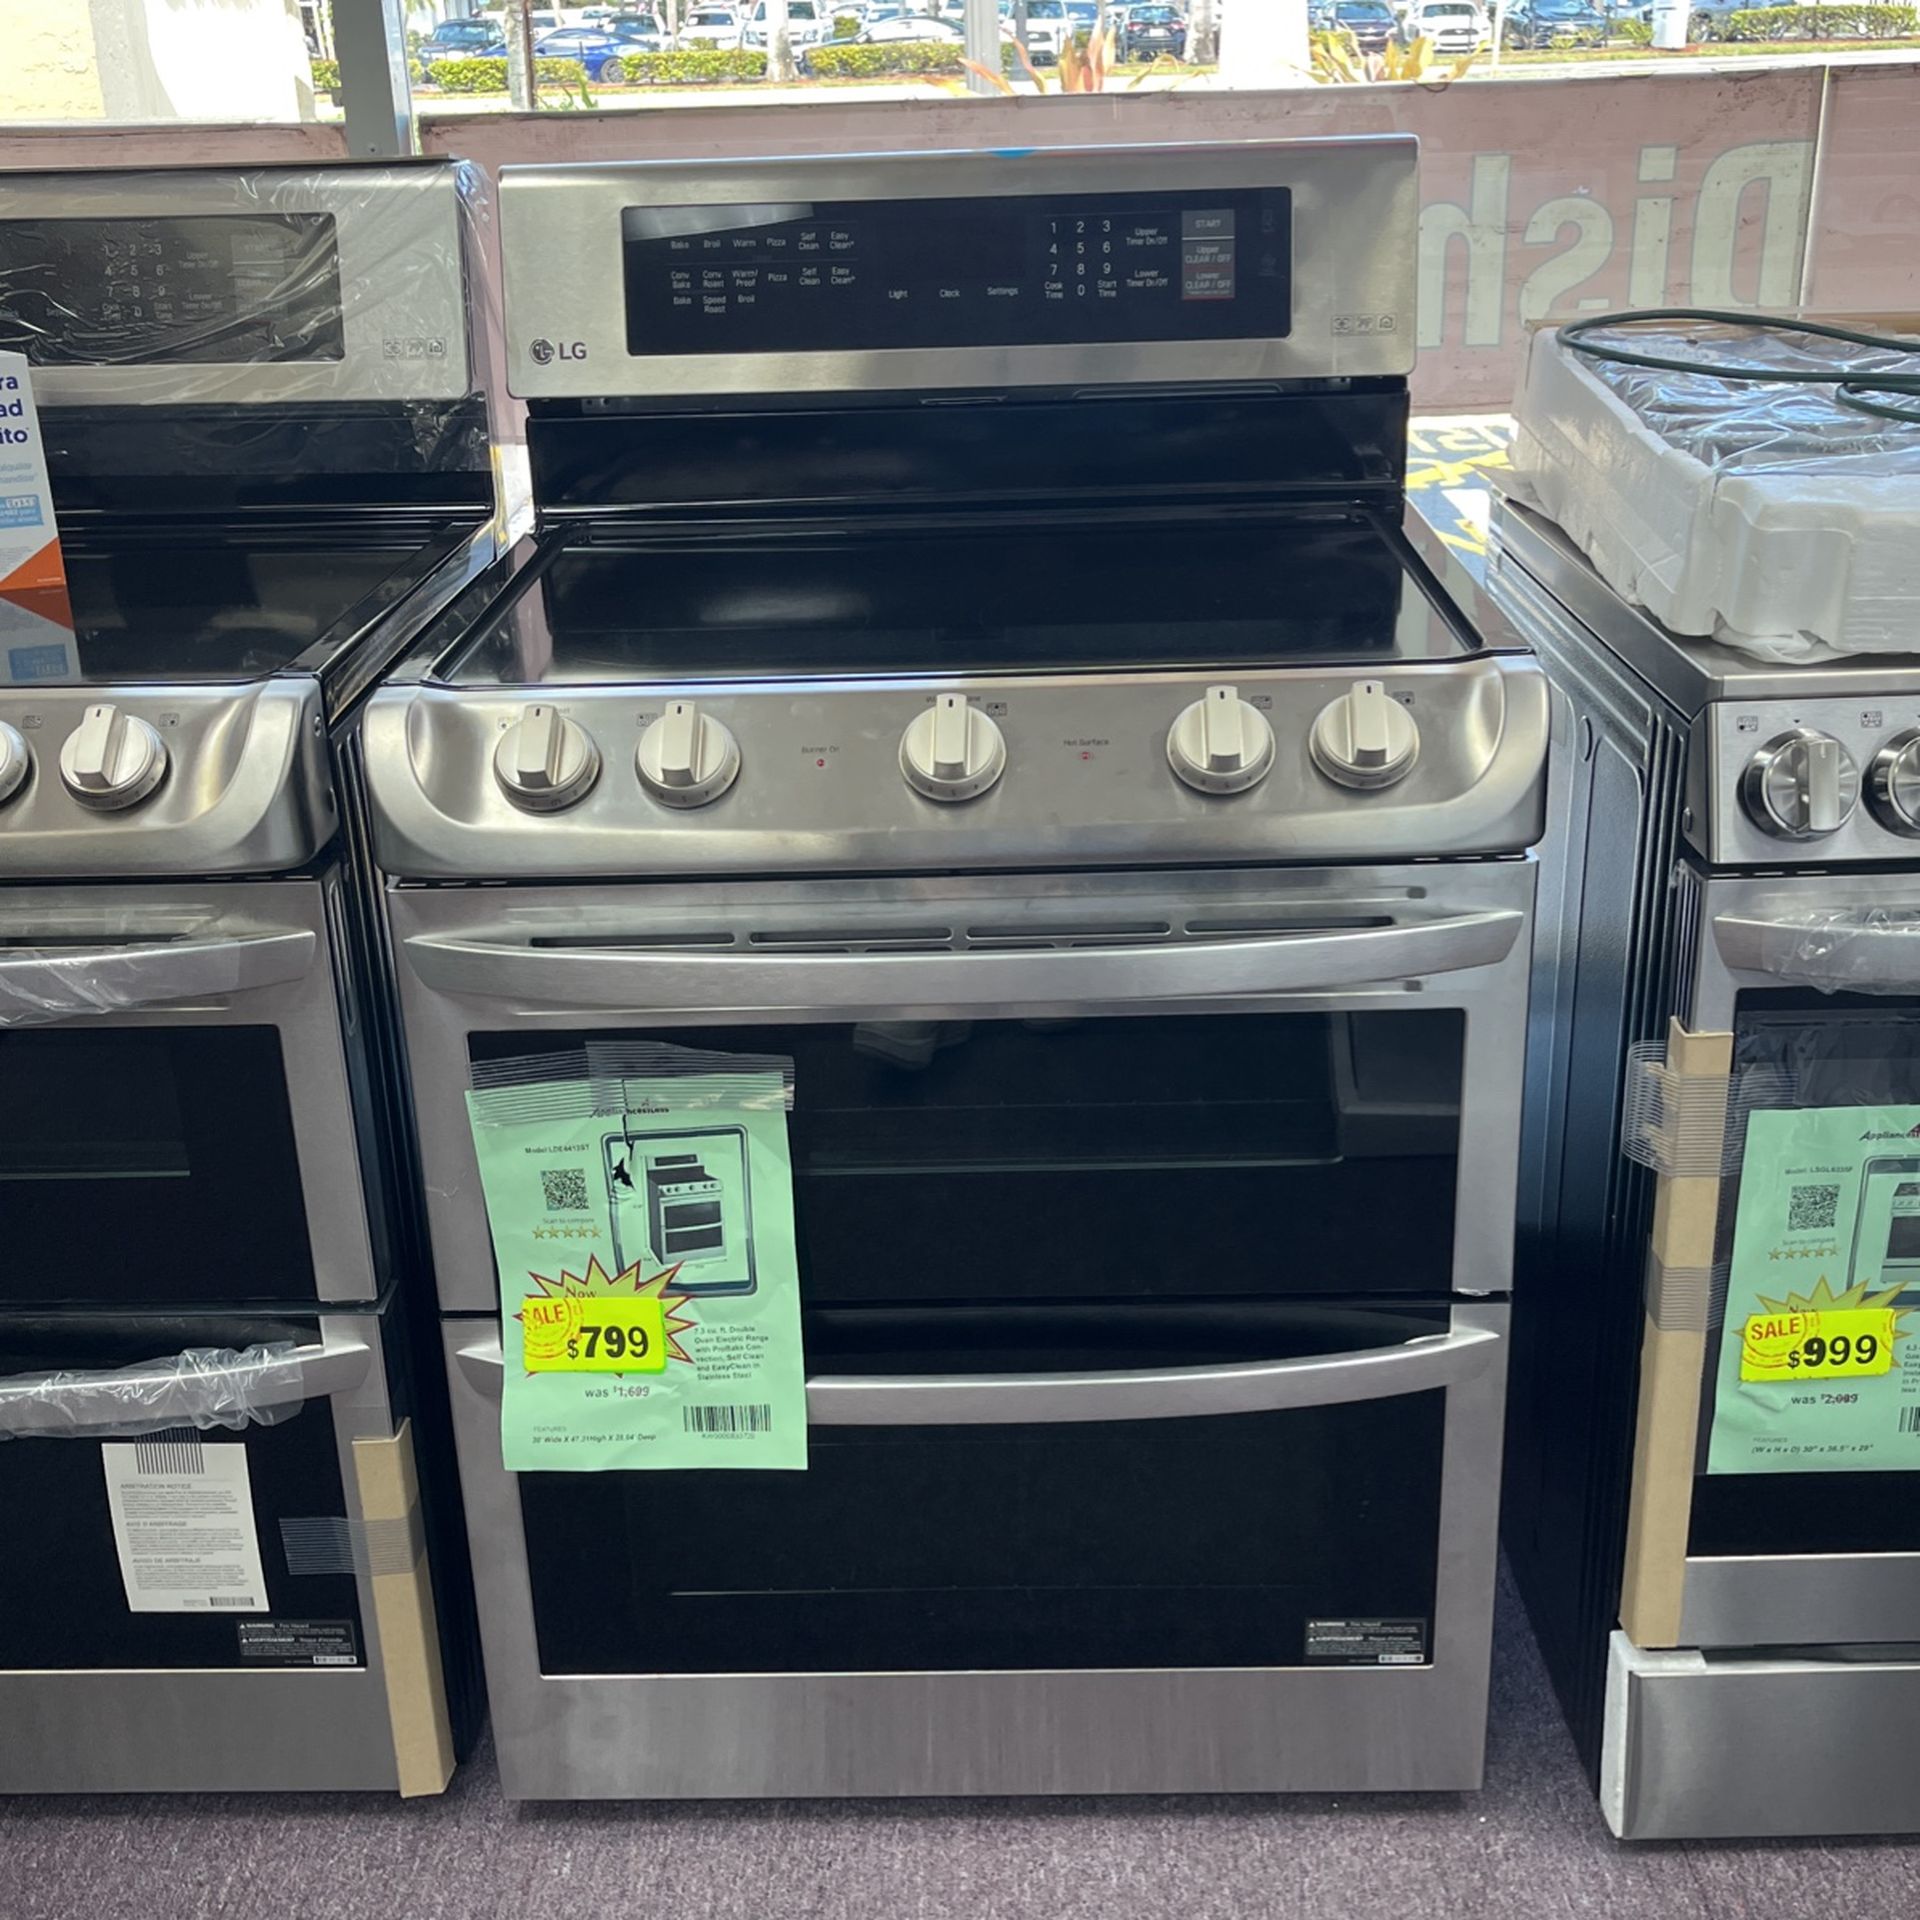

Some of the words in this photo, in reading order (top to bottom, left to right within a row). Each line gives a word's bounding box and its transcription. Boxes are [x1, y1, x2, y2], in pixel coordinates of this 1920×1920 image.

[1051, 222, 1057, 234] 1
[1077, 221, 1085, 233] 2
[1103, 220, 1111, 232] 3
[1049, 243, 1057, 254] 4
[1077, 242, 1085, 254] 5
[1103, 241, 1111, 253] 6
[1050, 264, 1058, 275] 7
[1077, 263, 1085, 275] 8
[1103, 262, 1111, 274] 9
[1077, 284, 1085, 296] 0
[559, 342, 587, 360] LG
[564, 1286, 598, 1298] Now
[1751, 1316, 1801, 1341] SALE
[567, 1326, 649, 1359] $799
[1788, 1334, 1877, 1369] $999
[585, 1388, 609, 1398] was
[1790, 1396, 1817, 1405] was
